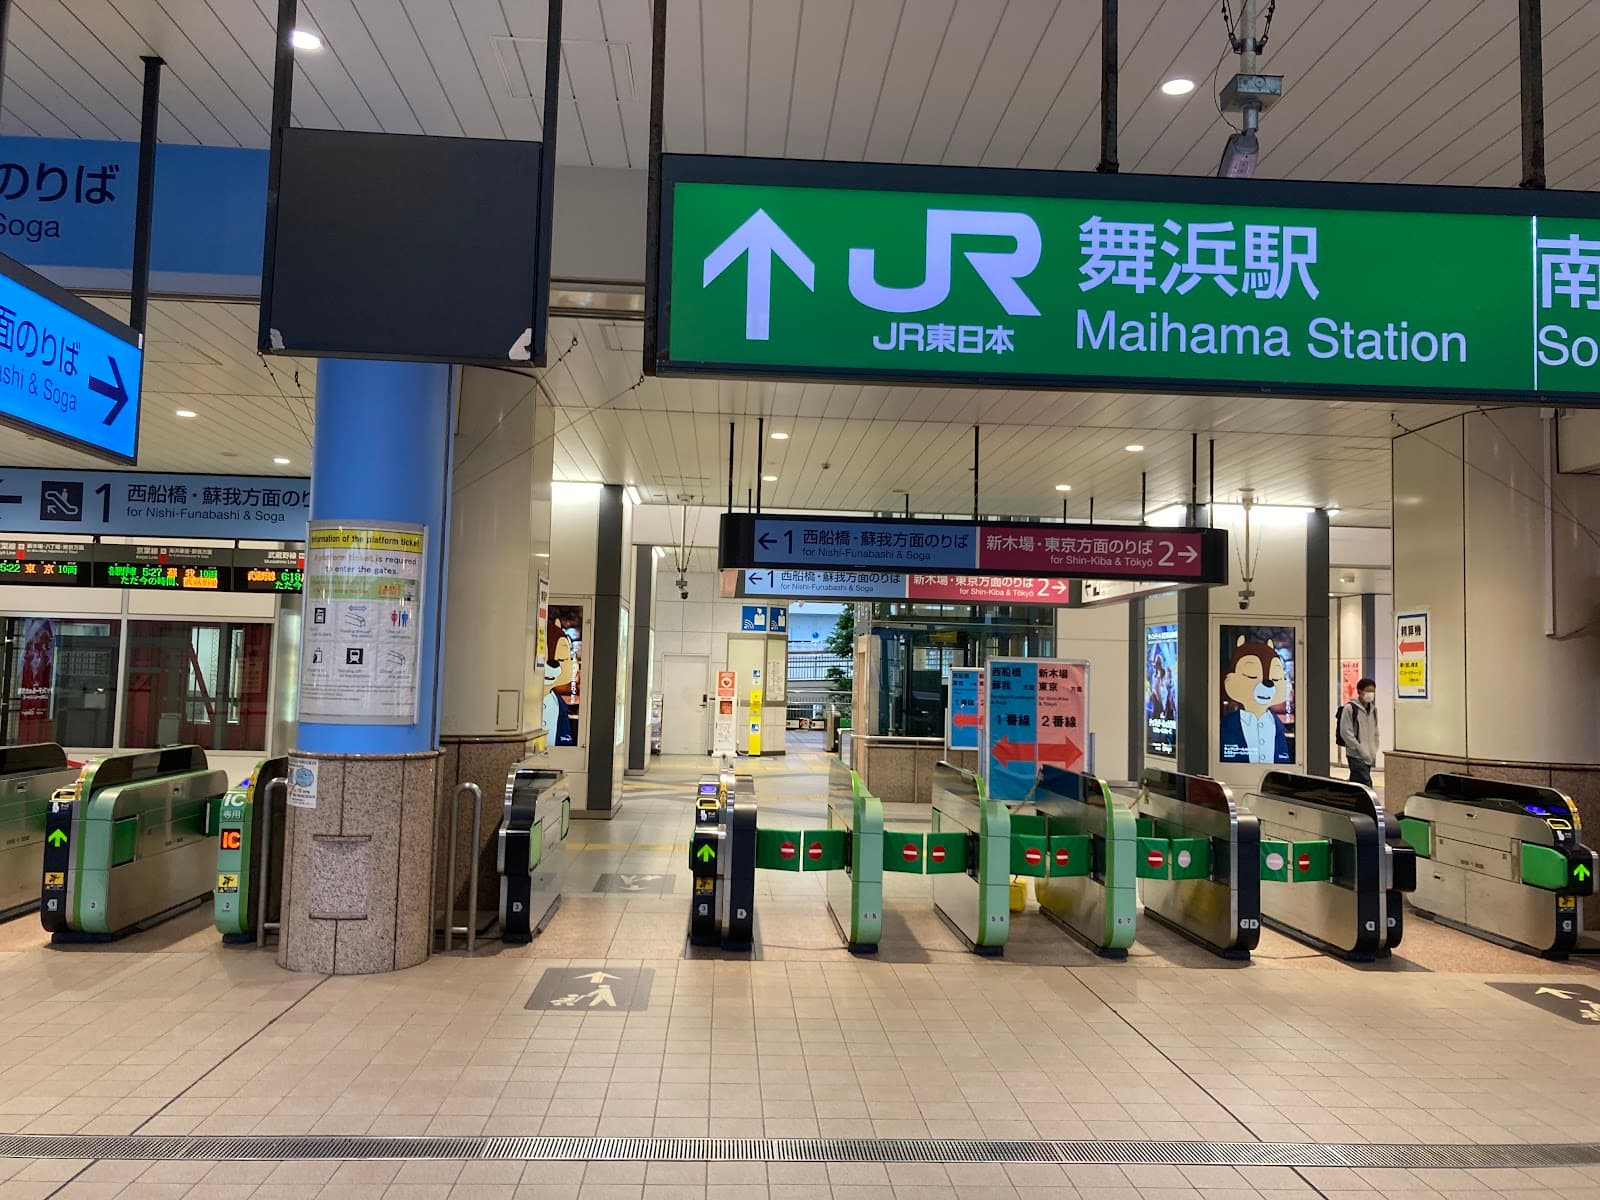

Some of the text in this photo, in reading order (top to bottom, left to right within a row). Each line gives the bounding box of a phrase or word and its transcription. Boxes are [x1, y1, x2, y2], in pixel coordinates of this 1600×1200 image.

[0, 162, 120, 204] のりば
[848, 207, 1042, 316] JR
[1077, 215, 1320, 301] 舞浜駅
[872, 321, 1015, 354] JR東日本
[1076, 308, 1467, 362] Maihama Station
[29, 373, 38, 396] &
[43, 378, 77, 413] Soga
[95, 483, 111, 523] 1
[127, 506, 285, 524] for Nishi-Funabashi & Soga
[342, 534, 350, 543] of
[352, 534, 364, 543] the
[366, 535, 399, 546] platform
[401, 538, 420, 547] ticket
[784, 529, 969, 554] 1 西船橋・蘇我方面のりば
[802, 547, 931, 561] for Nishi-Funabashi & Soga
[986, 535, 1175, 567] 新木場・東京方面のりば 2
[385, 557, 417, 566] required
[1050, 555, 1064, 565] for
[1065, 555, 1112, 566] Shin-Kiba
[1114, 558, 1122, 566] &
[142, 567, 163, 577] 5:27
[374, 568, 399, 576] gates.
[768, 570, 774, 588] 1
[791, 583, 847, 591] Nishi-Funabashi
[855, 585, 873, 593] Soga
[970, 588, 1004, 596] Shin-Kiba
[1037, 578, 1050, 597] 2
[1039, 668, 1068, 679] 新木場
[1039, 682, 1058, 692] 東京
[1041, 715, 1077, 728] 2番線
[223, 793, 246, 807] IC
[222, 831, 240, 849] IC
